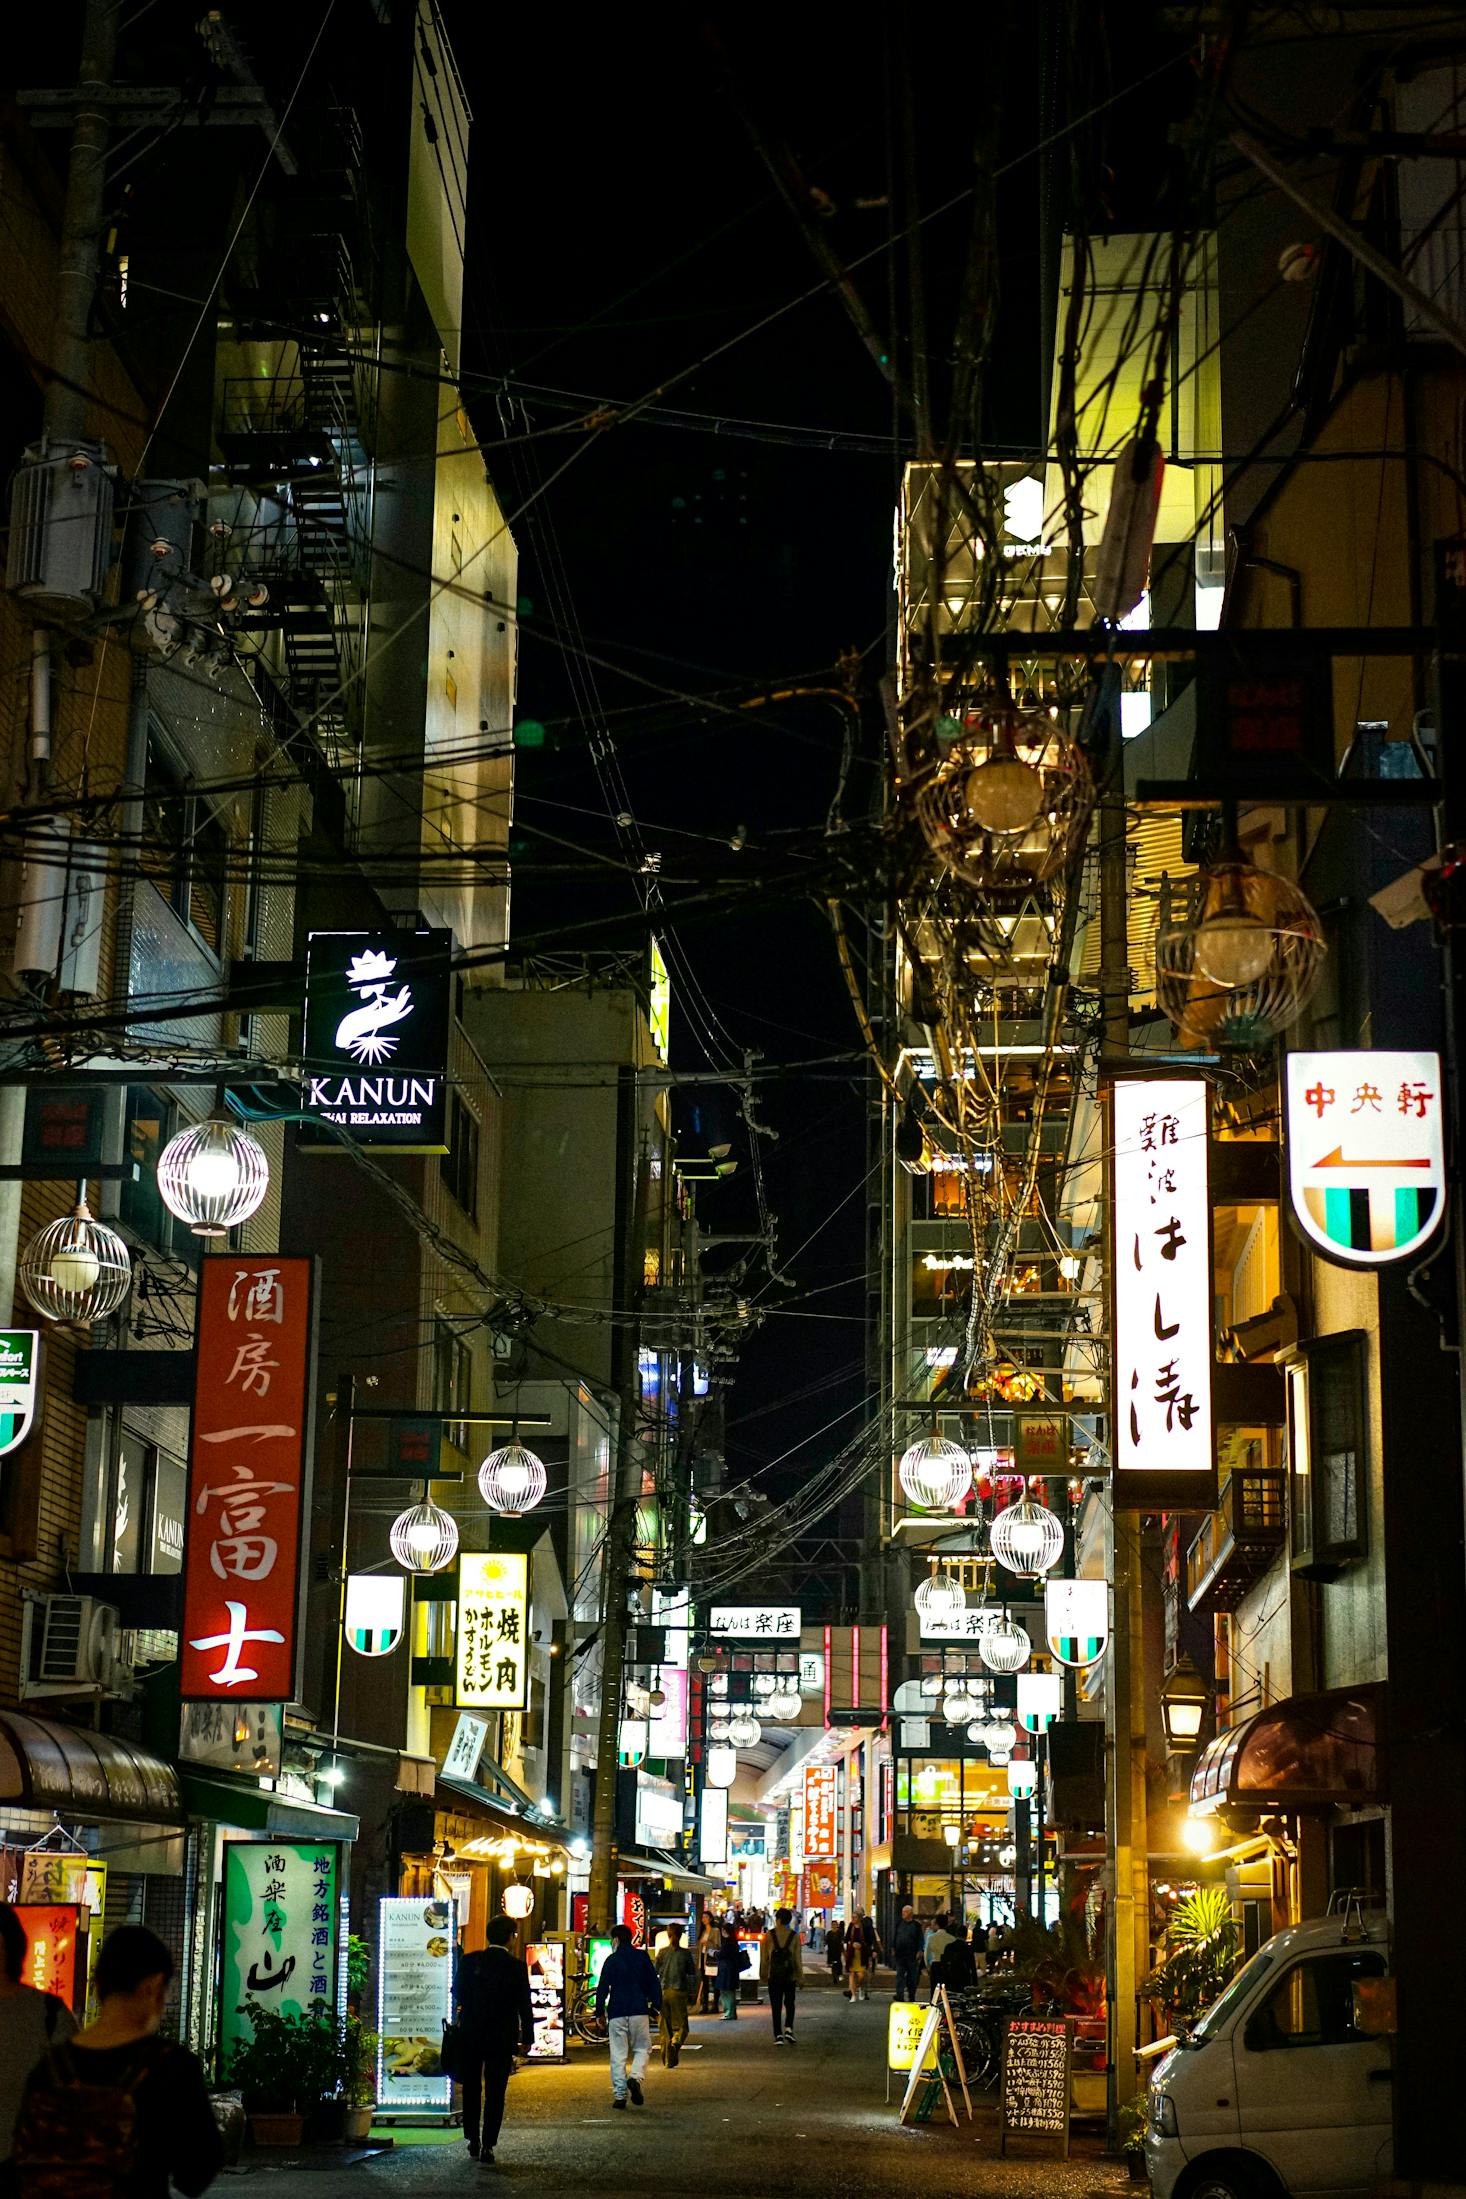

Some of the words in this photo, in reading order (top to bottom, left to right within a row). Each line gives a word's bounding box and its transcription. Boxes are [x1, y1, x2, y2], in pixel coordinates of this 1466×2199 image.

[309, 1077, 436, 1106] KANUN
[1305, 1081, 1434, 1119] 中央軒
[350, 1112, 422, 1125] RELAXATION
[188, 1268, 297, 1687] 酒房一富士
[157, 1512, 184, 1548] KANUN
[462, 1607, 479, 1693] かすうどん
[479, 1606, 494, 1693] ホルモン
[496, 1608, 520, 1693] 焼肉
[389, 1913, 421, 1921] KANUN
[631, 1897, 645, 1949] おでん
[247, 1950, 296, 1993] 山
[1009, 2021, 1066, 2034] おすすめ料理
